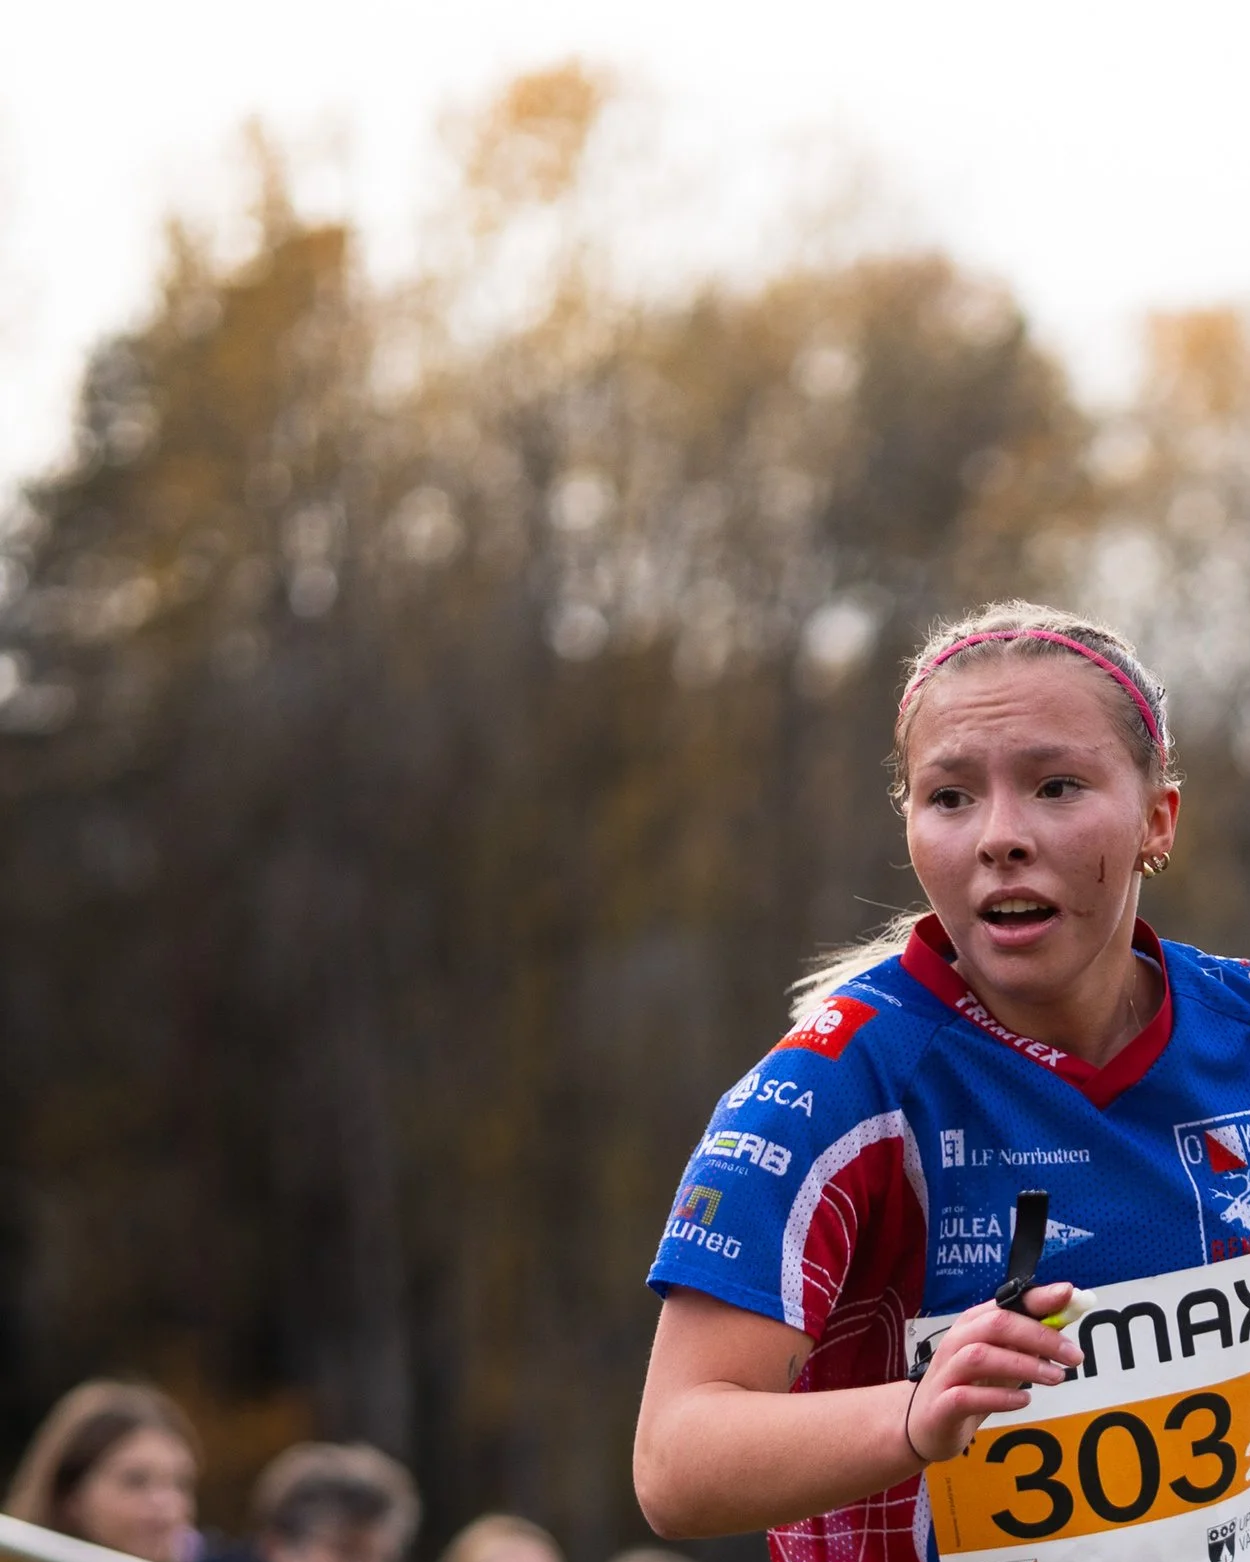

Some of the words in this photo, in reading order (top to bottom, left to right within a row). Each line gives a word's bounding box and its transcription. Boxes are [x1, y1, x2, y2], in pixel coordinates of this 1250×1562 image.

[756, 1079, 814, 1117] SCA
[971, 1149, 994, 1167] LF
[999, 1147, 1091, 1167] Norrbotten
[939, 1213, 1003, 1240] LULEÅ
[936, 1243, 1002, 1265] HAMN
[985, 1391, 1238, 1540] 303
